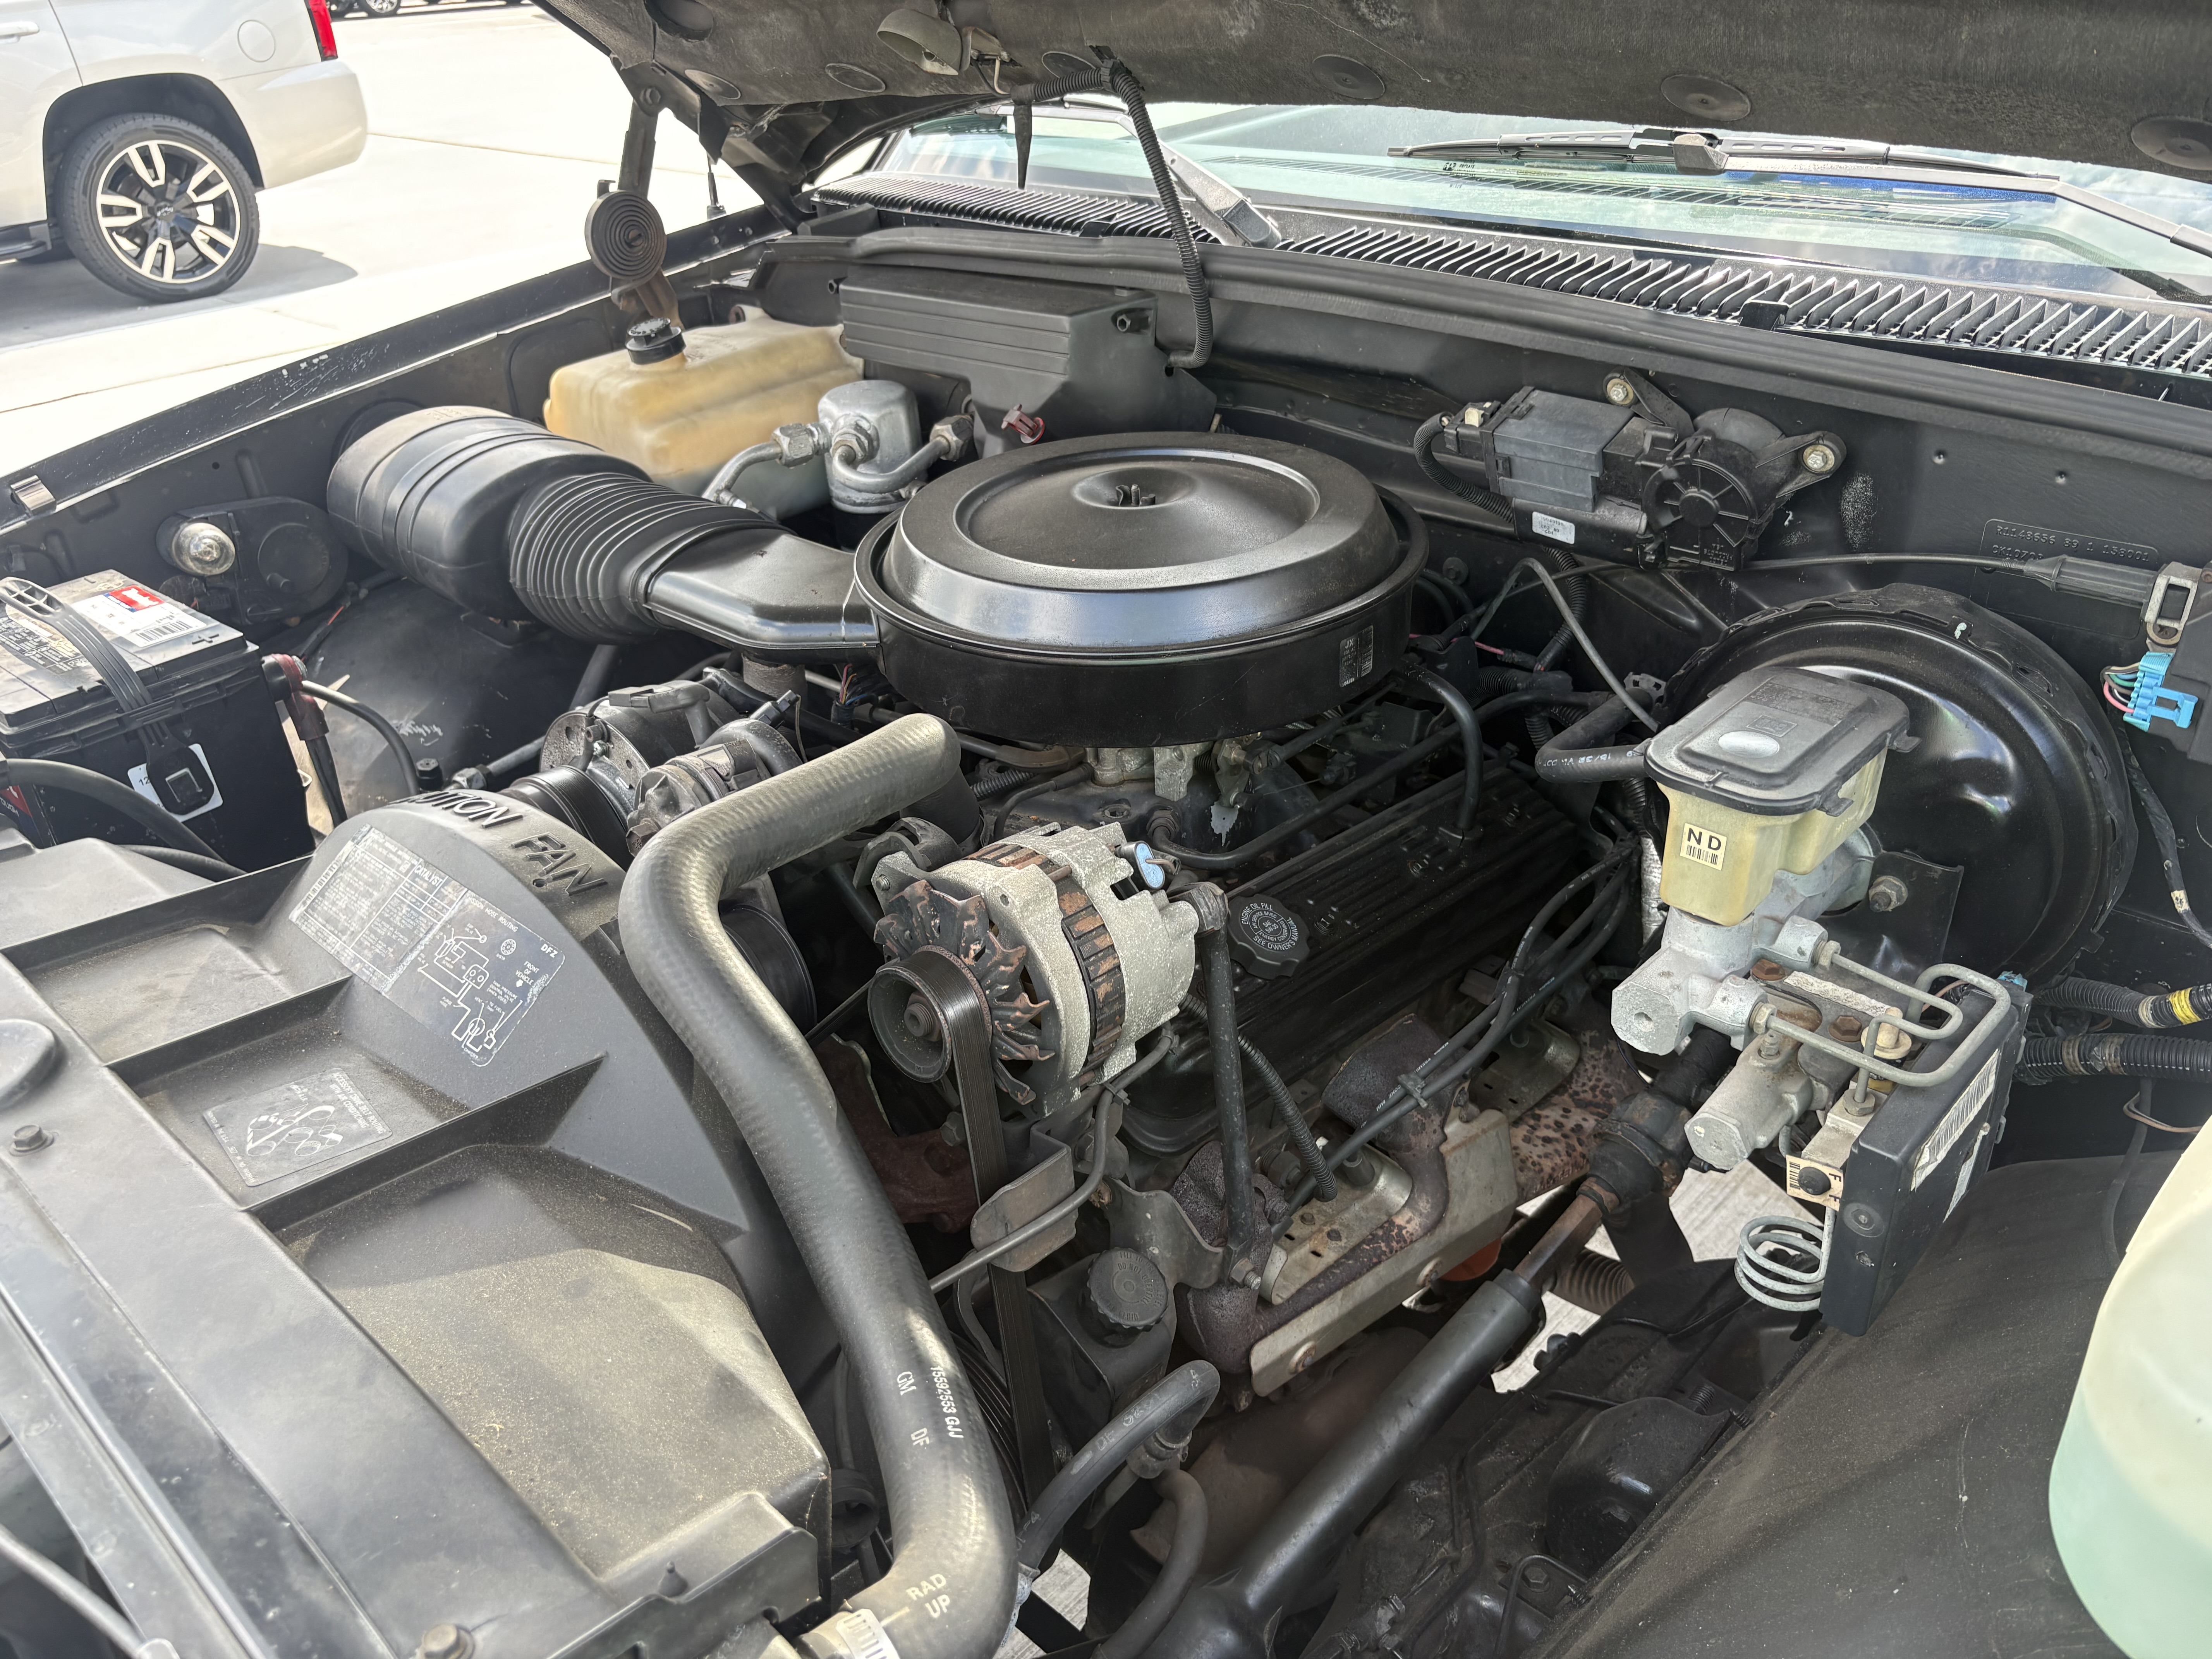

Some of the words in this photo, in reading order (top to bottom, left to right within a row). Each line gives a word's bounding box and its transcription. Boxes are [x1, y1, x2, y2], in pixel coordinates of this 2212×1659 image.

[2064, 538, 2079, 548] 89
[2087, 542, 2093, 551] 1
[2102, 545, 2149, 562] 158001
[0, 797, 19, 817] OUGH
[413, 864, 444, 888] CATALYST
[511, 832, 608, 896] FAN
[497, 915, 519, 933] ROUTING
[1242, 906, 1252, 925] ENGINE
[1253, 936, 1265, 946] SEE
[1286, 917, 1298, 941] MANUAL
[539, 943, 558, 958] DFZ
[514, 970, 534, 986] VEHICLE
[523, 960, 540, 974] FRONT
[523, 968, 532, 976] OF
[348, 1093, 364, 1106] DRIVE
[358, 1104, 373, 1116] BELT
[366, 1115, 387, 1134] ROUTING
[897, 1371, 916, 1396] GM
[910, 1428, 930, 1446] DF
[931, 1365, 957, 1413] 15592553
[945, 1417, 964, 1439] GJJ
[906, 1573, 947, 1601] RAD
[924, 1594, 951, 1619] UP
